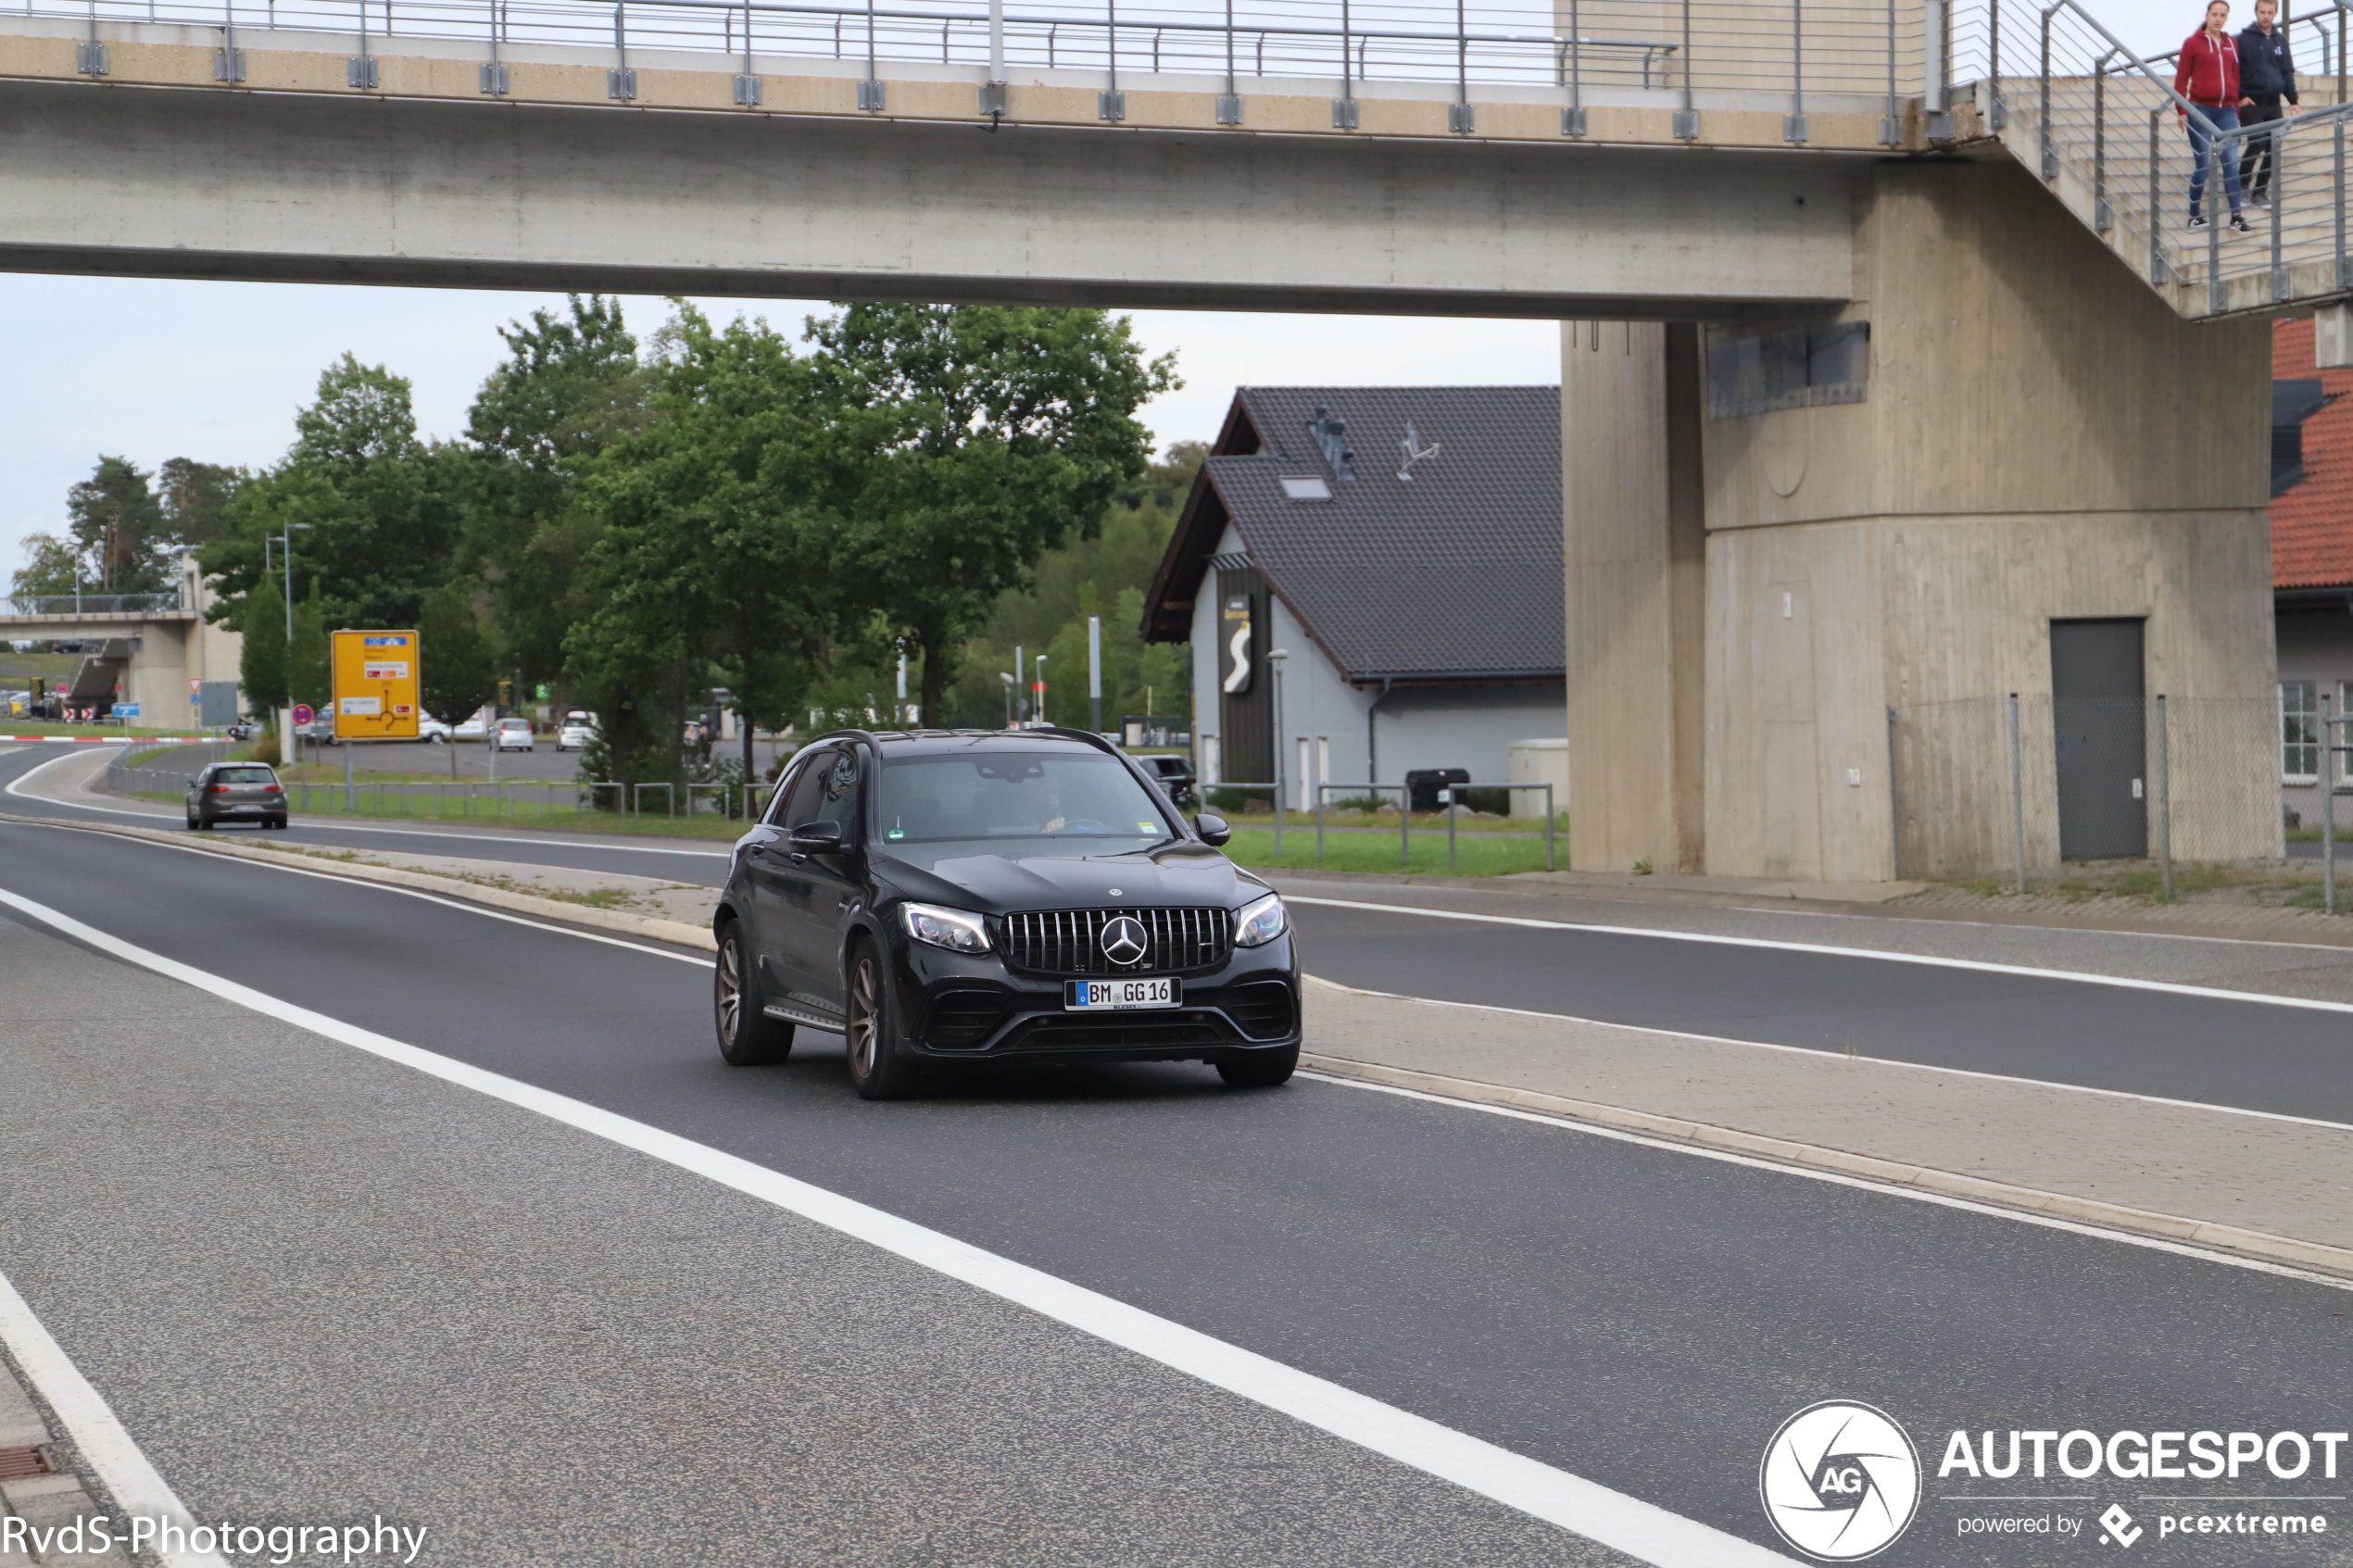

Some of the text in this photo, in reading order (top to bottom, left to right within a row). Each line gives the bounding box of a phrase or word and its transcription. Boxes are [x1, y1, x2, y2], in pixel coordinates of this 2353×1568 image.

[1089, 985, 1111, 1003] BM
[1124, 983, 1145, 1001] GG
[1149, 982, 1168, 1000] 16
